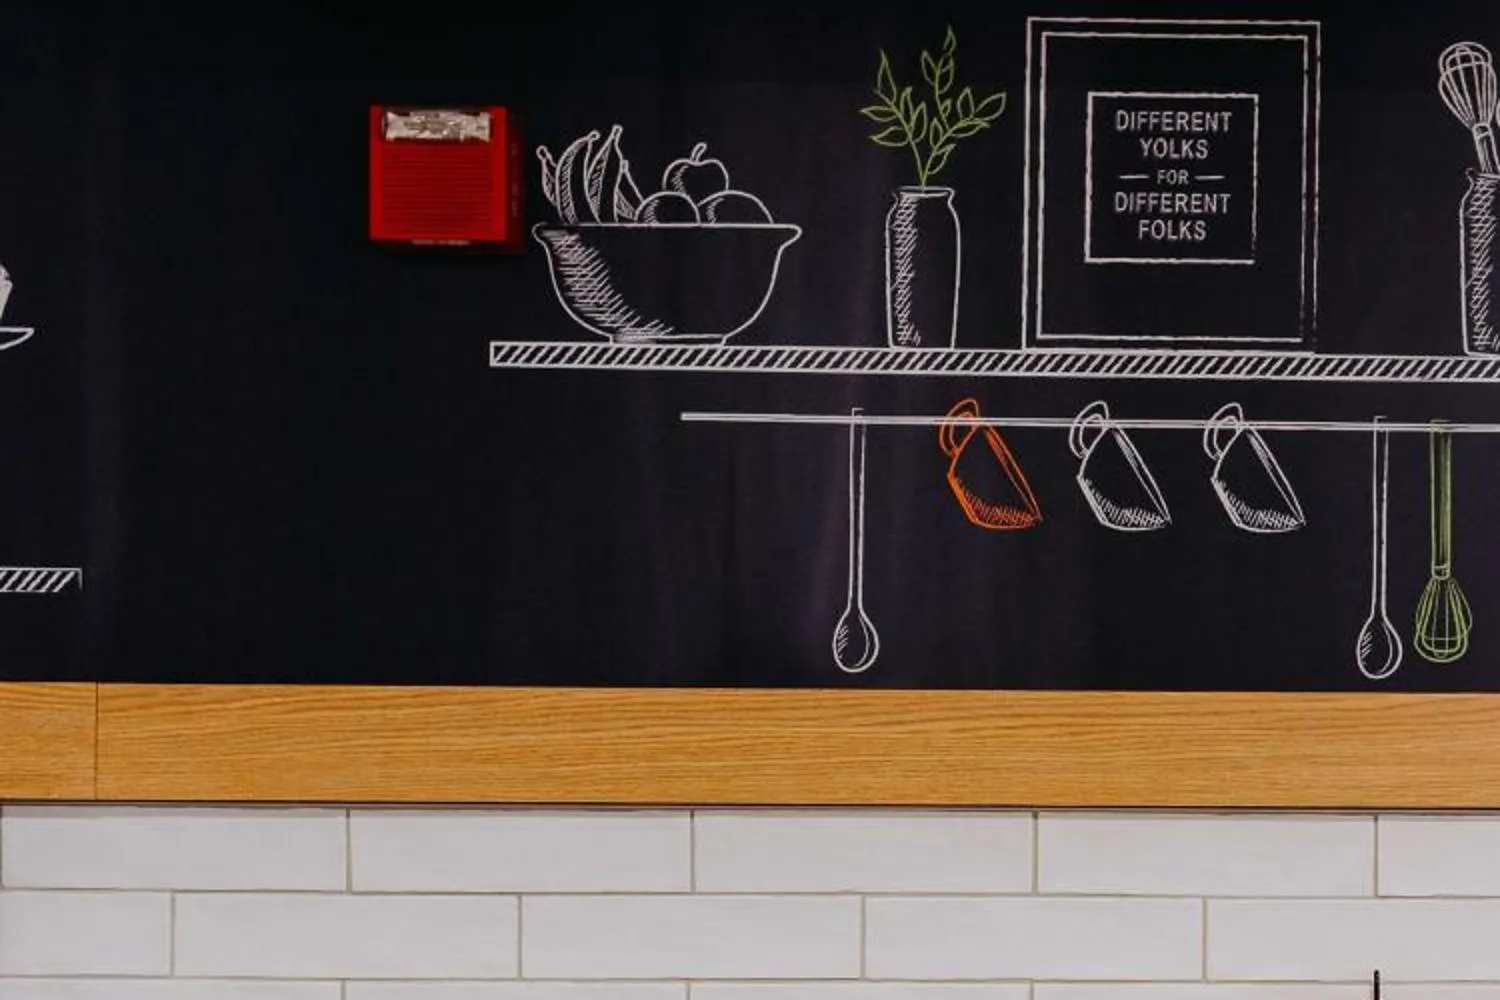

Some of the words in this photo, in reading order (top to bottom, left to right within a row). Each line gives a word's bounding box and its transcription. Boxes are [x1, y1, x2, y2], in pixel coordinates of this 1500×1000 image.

[1115, 109, 1232, 132] DIFFERENT
[1139, 138, 1209, 160] YOLKS
[1156, 169, 1189, 185] FOR
[1114, 191, 1232, 214] DIFFERENT
[1138, 219, 1207, 241] FOLKS
